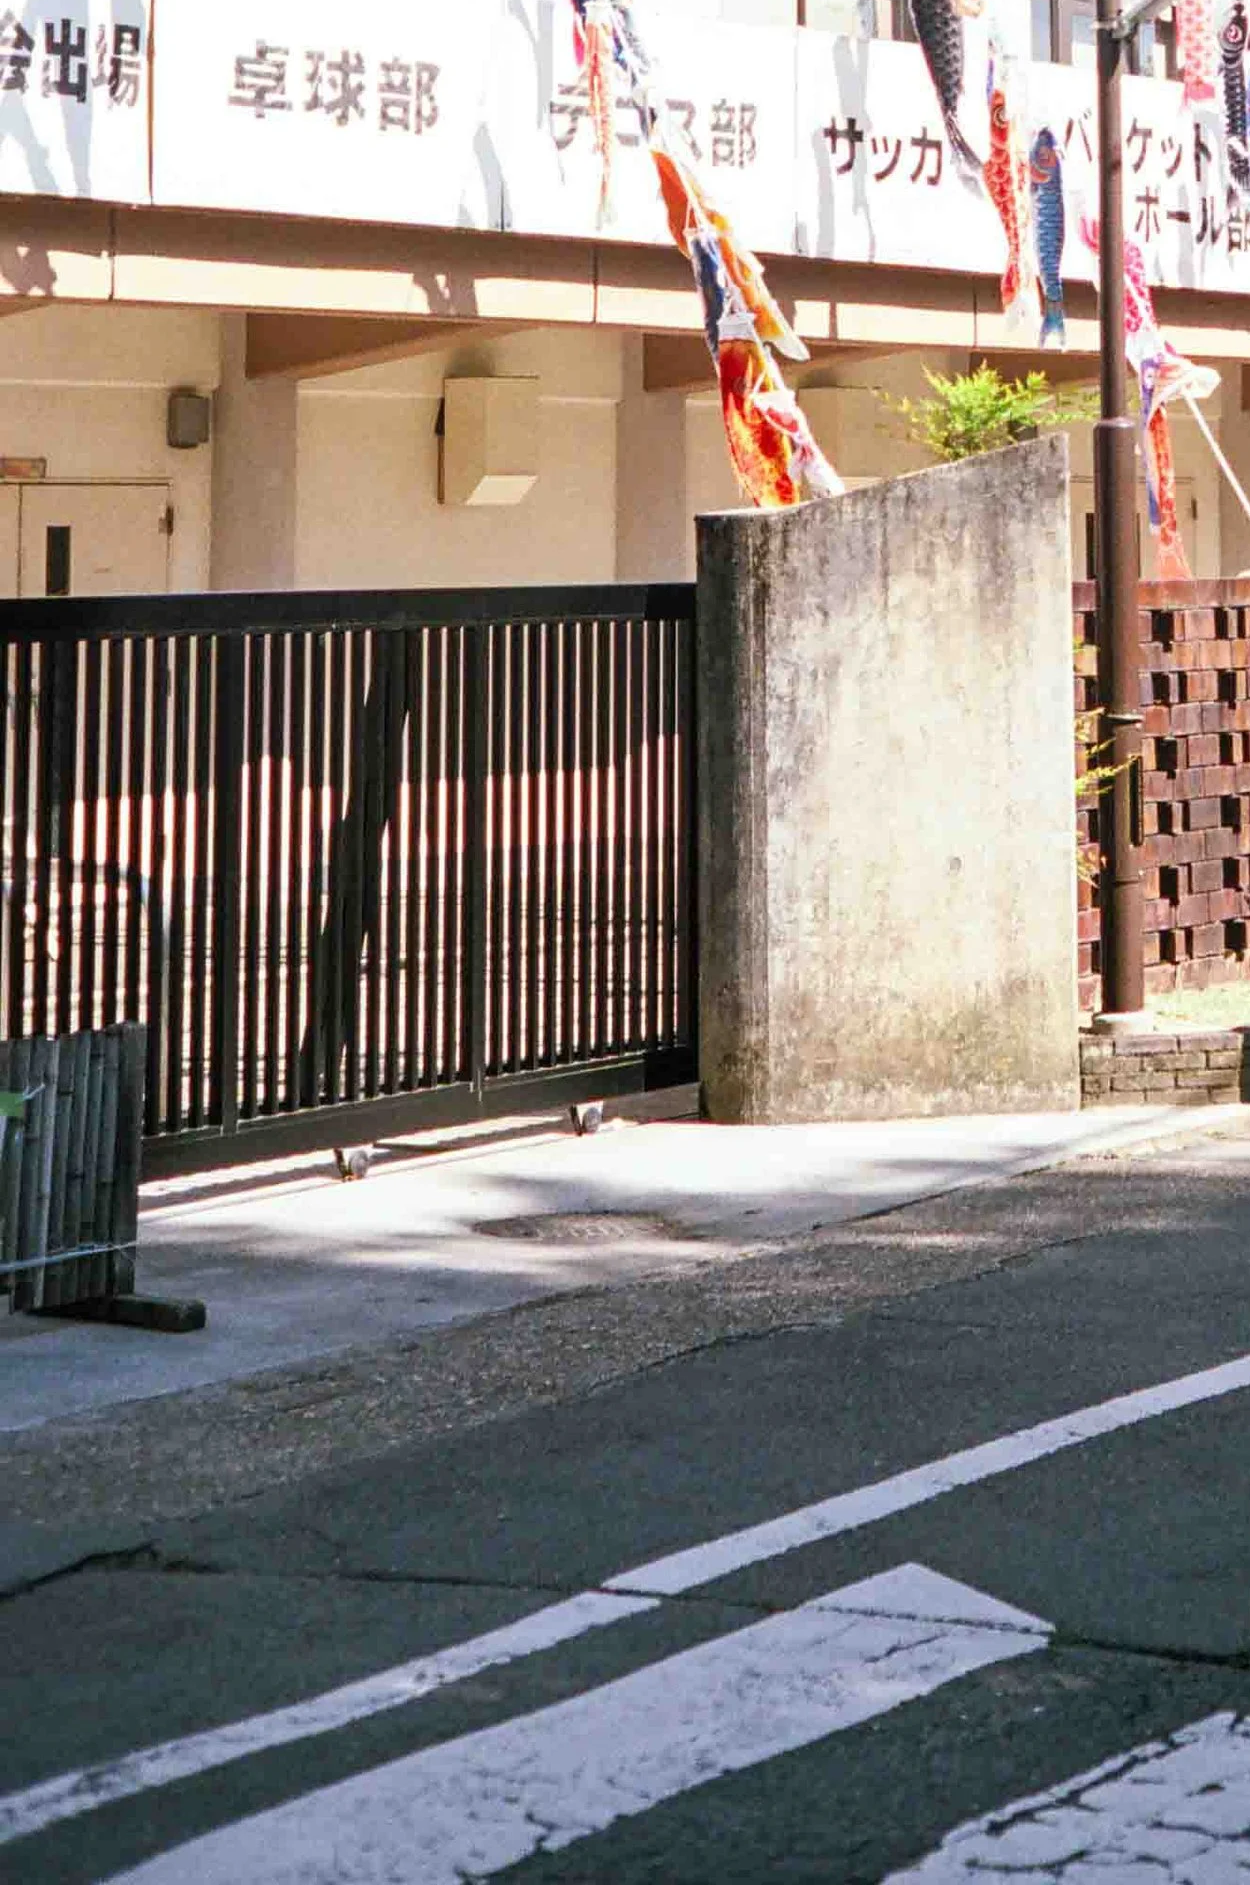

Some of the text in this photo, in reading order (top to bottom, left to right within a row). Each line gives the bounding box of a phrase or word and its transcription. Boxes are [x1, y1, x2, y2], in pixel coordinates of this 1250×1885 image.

[227, 37, 442, 136] 卓球部
[823, 116, 944, 188] サッカ
[1063, 107, 1212, 183] バケット
